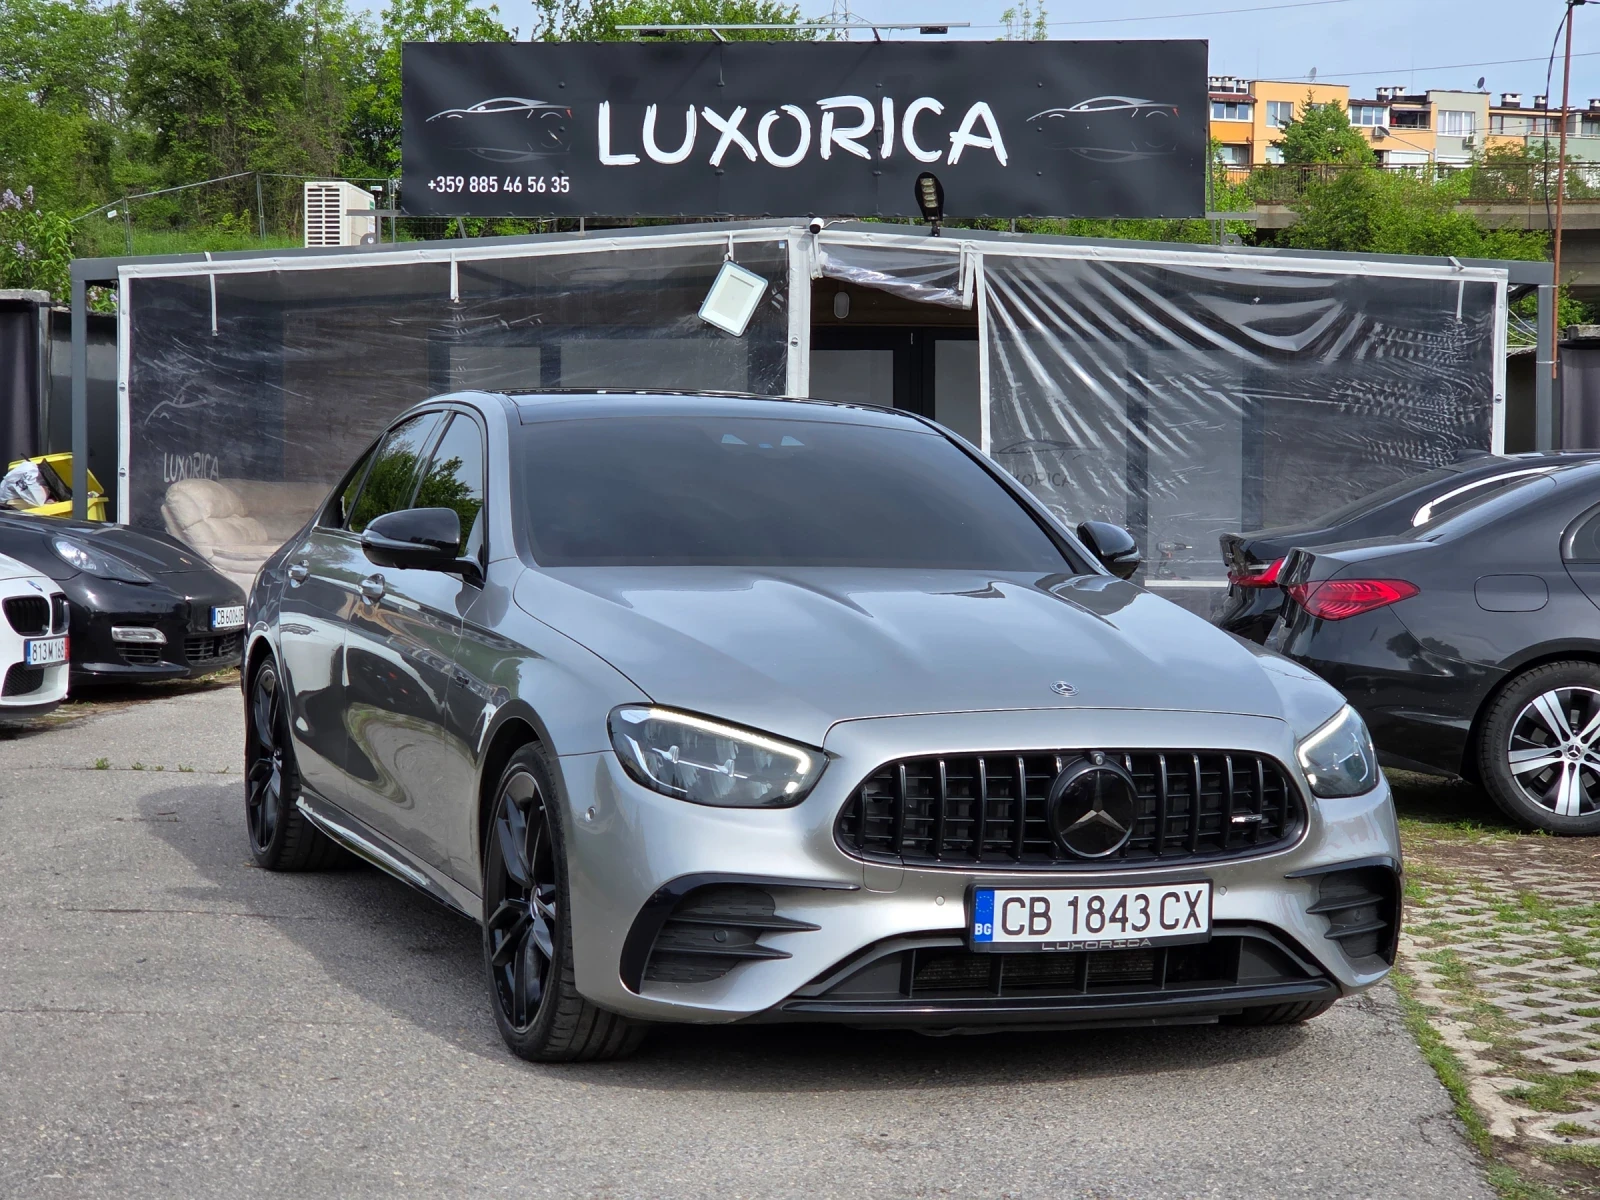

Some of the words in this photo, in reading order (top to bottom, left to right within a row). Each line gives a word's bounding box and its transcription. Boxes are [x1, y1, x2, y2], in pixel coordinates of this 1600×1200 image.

[598, 95, 1008, 168] LUXORICA
[427, 175, 465, 193] +359
[469, 175, 498, 193] 885
[503, 176, 523, 193] 46
[527, 176, 546, 193] 56
[550, 176, 570, 193] 35
[163, 452, 219, 483] LUXORICA
[217, 609, 225, 625] CB
[32, 642, 47, 662] 813
[1001, 896, 1053, 936] CB
[1067, 893, 1151, 935] 1843
[1159, 890, 1204, 931] CX
[974, 923, 992, 936] BG
[1041, 938, 1152, 951] LUXORICA
